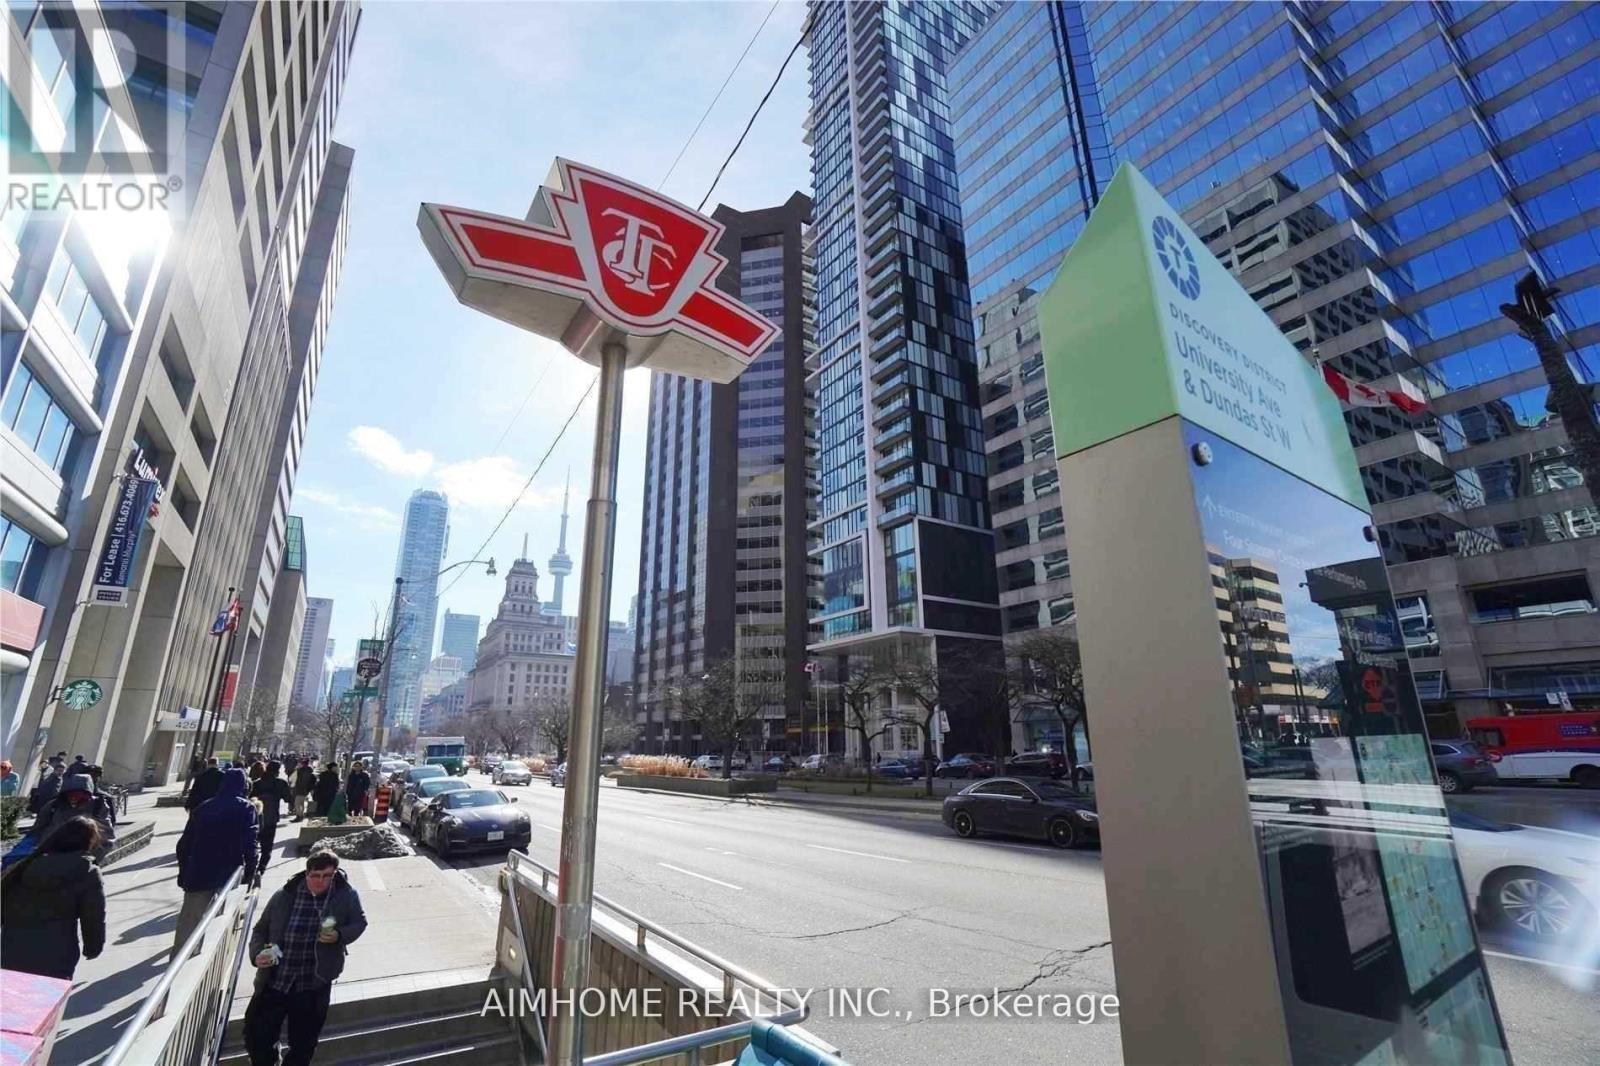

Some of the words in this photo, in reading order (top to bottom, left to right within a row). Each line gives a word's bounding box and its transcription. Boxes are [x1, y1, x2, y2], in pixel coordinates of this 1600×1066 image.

[1169, 302, 1239, 361] DISCOVERY
[1241, 353, 1287, 395] DISTRICT
[1174, 331, 1254, 404] University
[1257, 386, 1282, 418] Ave
[1183, 368, 1197, 397] &
[1200, 378, 1259, 432] Dundas
[1261, 415, 1277, 442] St
[1276, 423, 1292, 451] W
[99, 566, 113, 583] For
[104, 538, 120, 565] Lease
